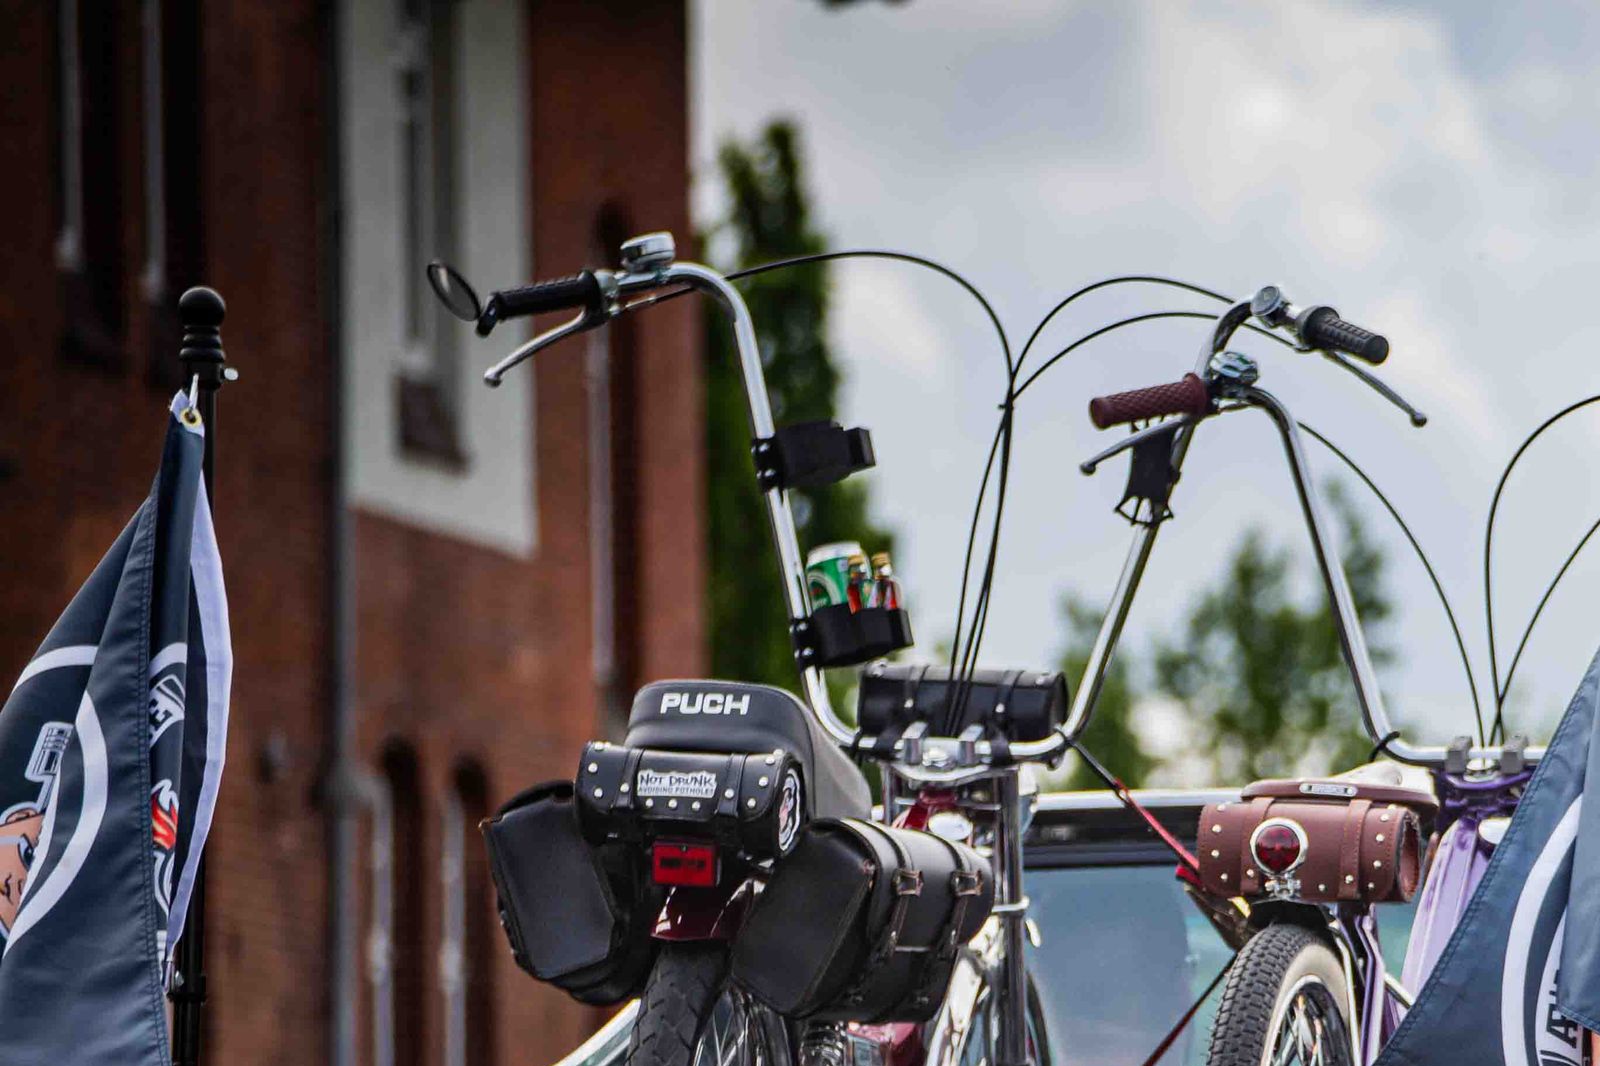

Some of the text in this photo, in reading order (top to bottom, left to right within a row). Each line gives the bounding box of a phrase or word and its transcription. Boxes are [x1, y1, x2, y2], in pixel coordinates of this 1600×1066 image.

[660, 693, 750, 715] PUCH
[640, 773, 714, 787] NOT DRUNK
